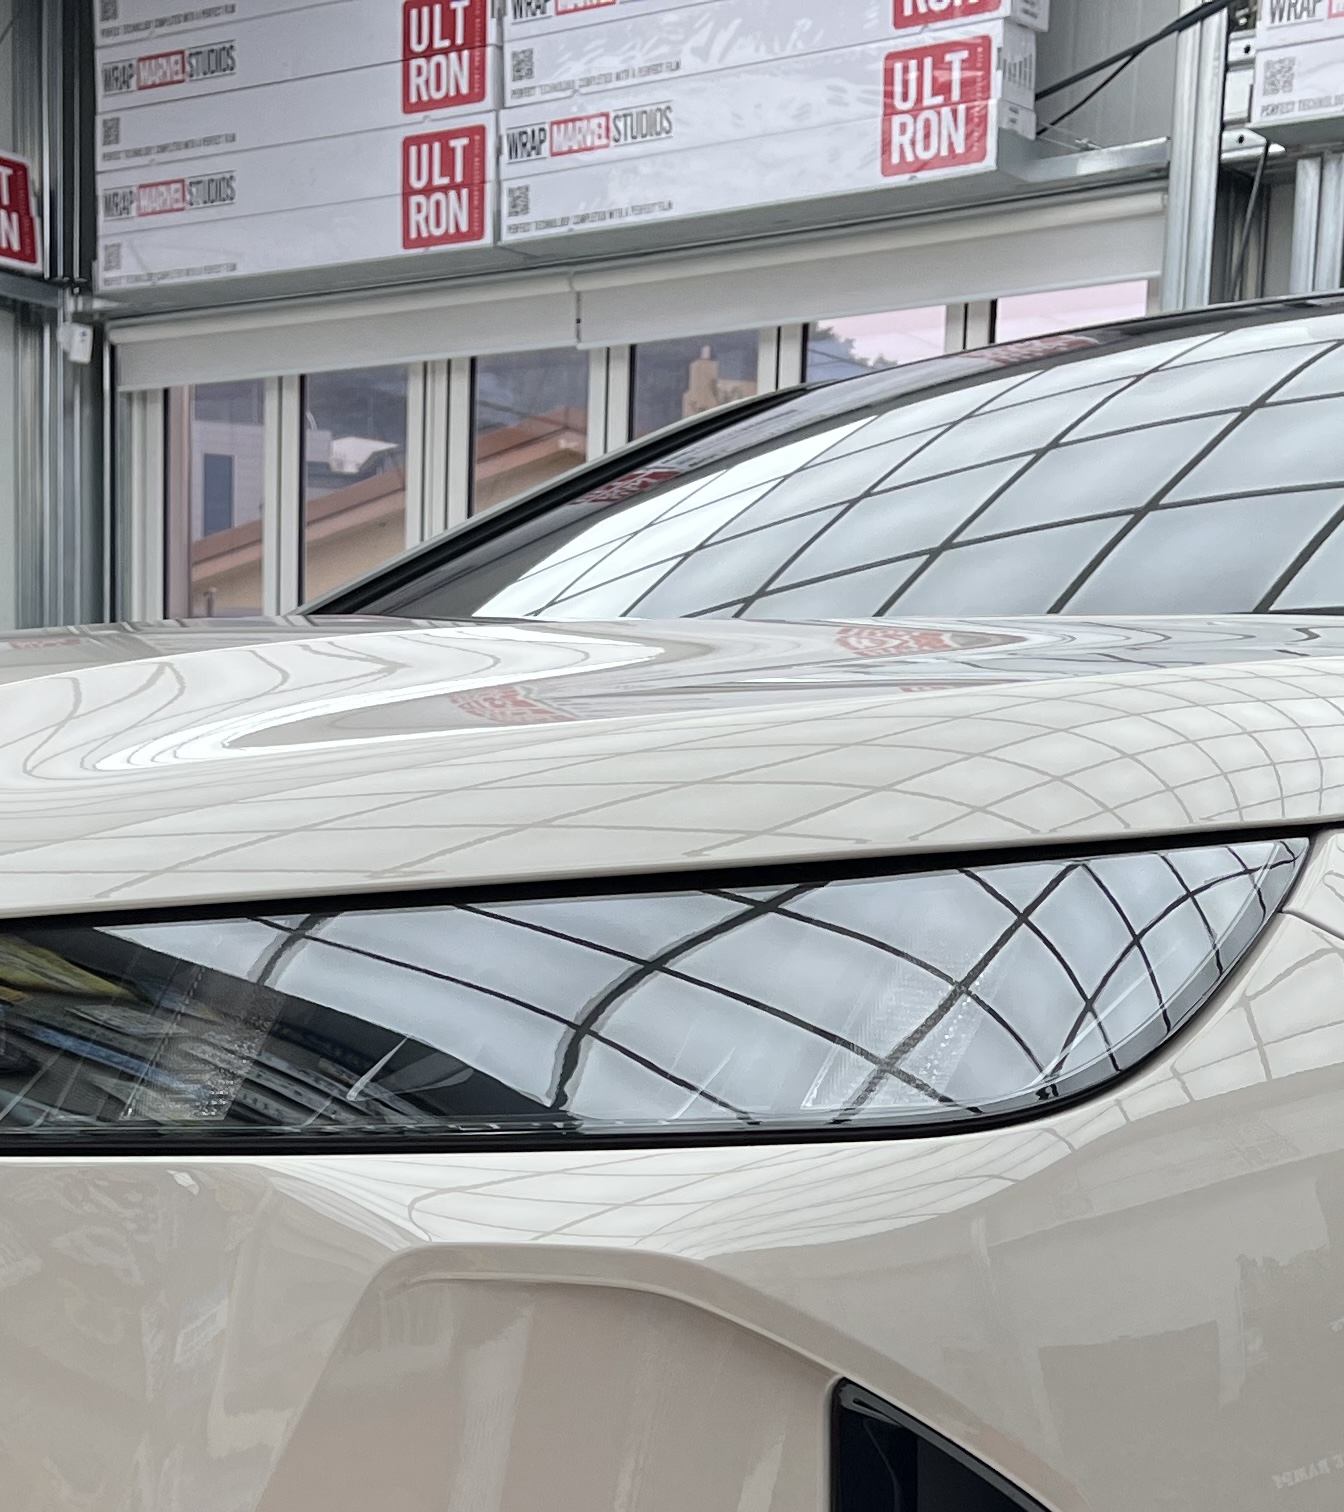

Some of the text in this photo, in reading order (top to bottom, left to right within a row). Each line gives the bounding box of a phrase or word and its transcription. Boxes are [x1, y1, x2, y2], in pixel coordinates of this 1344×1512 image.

[409, 1, 470, 52] ULT
[409, 49, 470, 103] RON
[893, 50, 969, 110] ULT
[507, 105, 673, 160] WRAP MARVEL STUDIOS
[891, 104, 967, 165] RON
[409, 137, 470, 189] ULT
[409, 188, 469, 239] RON
